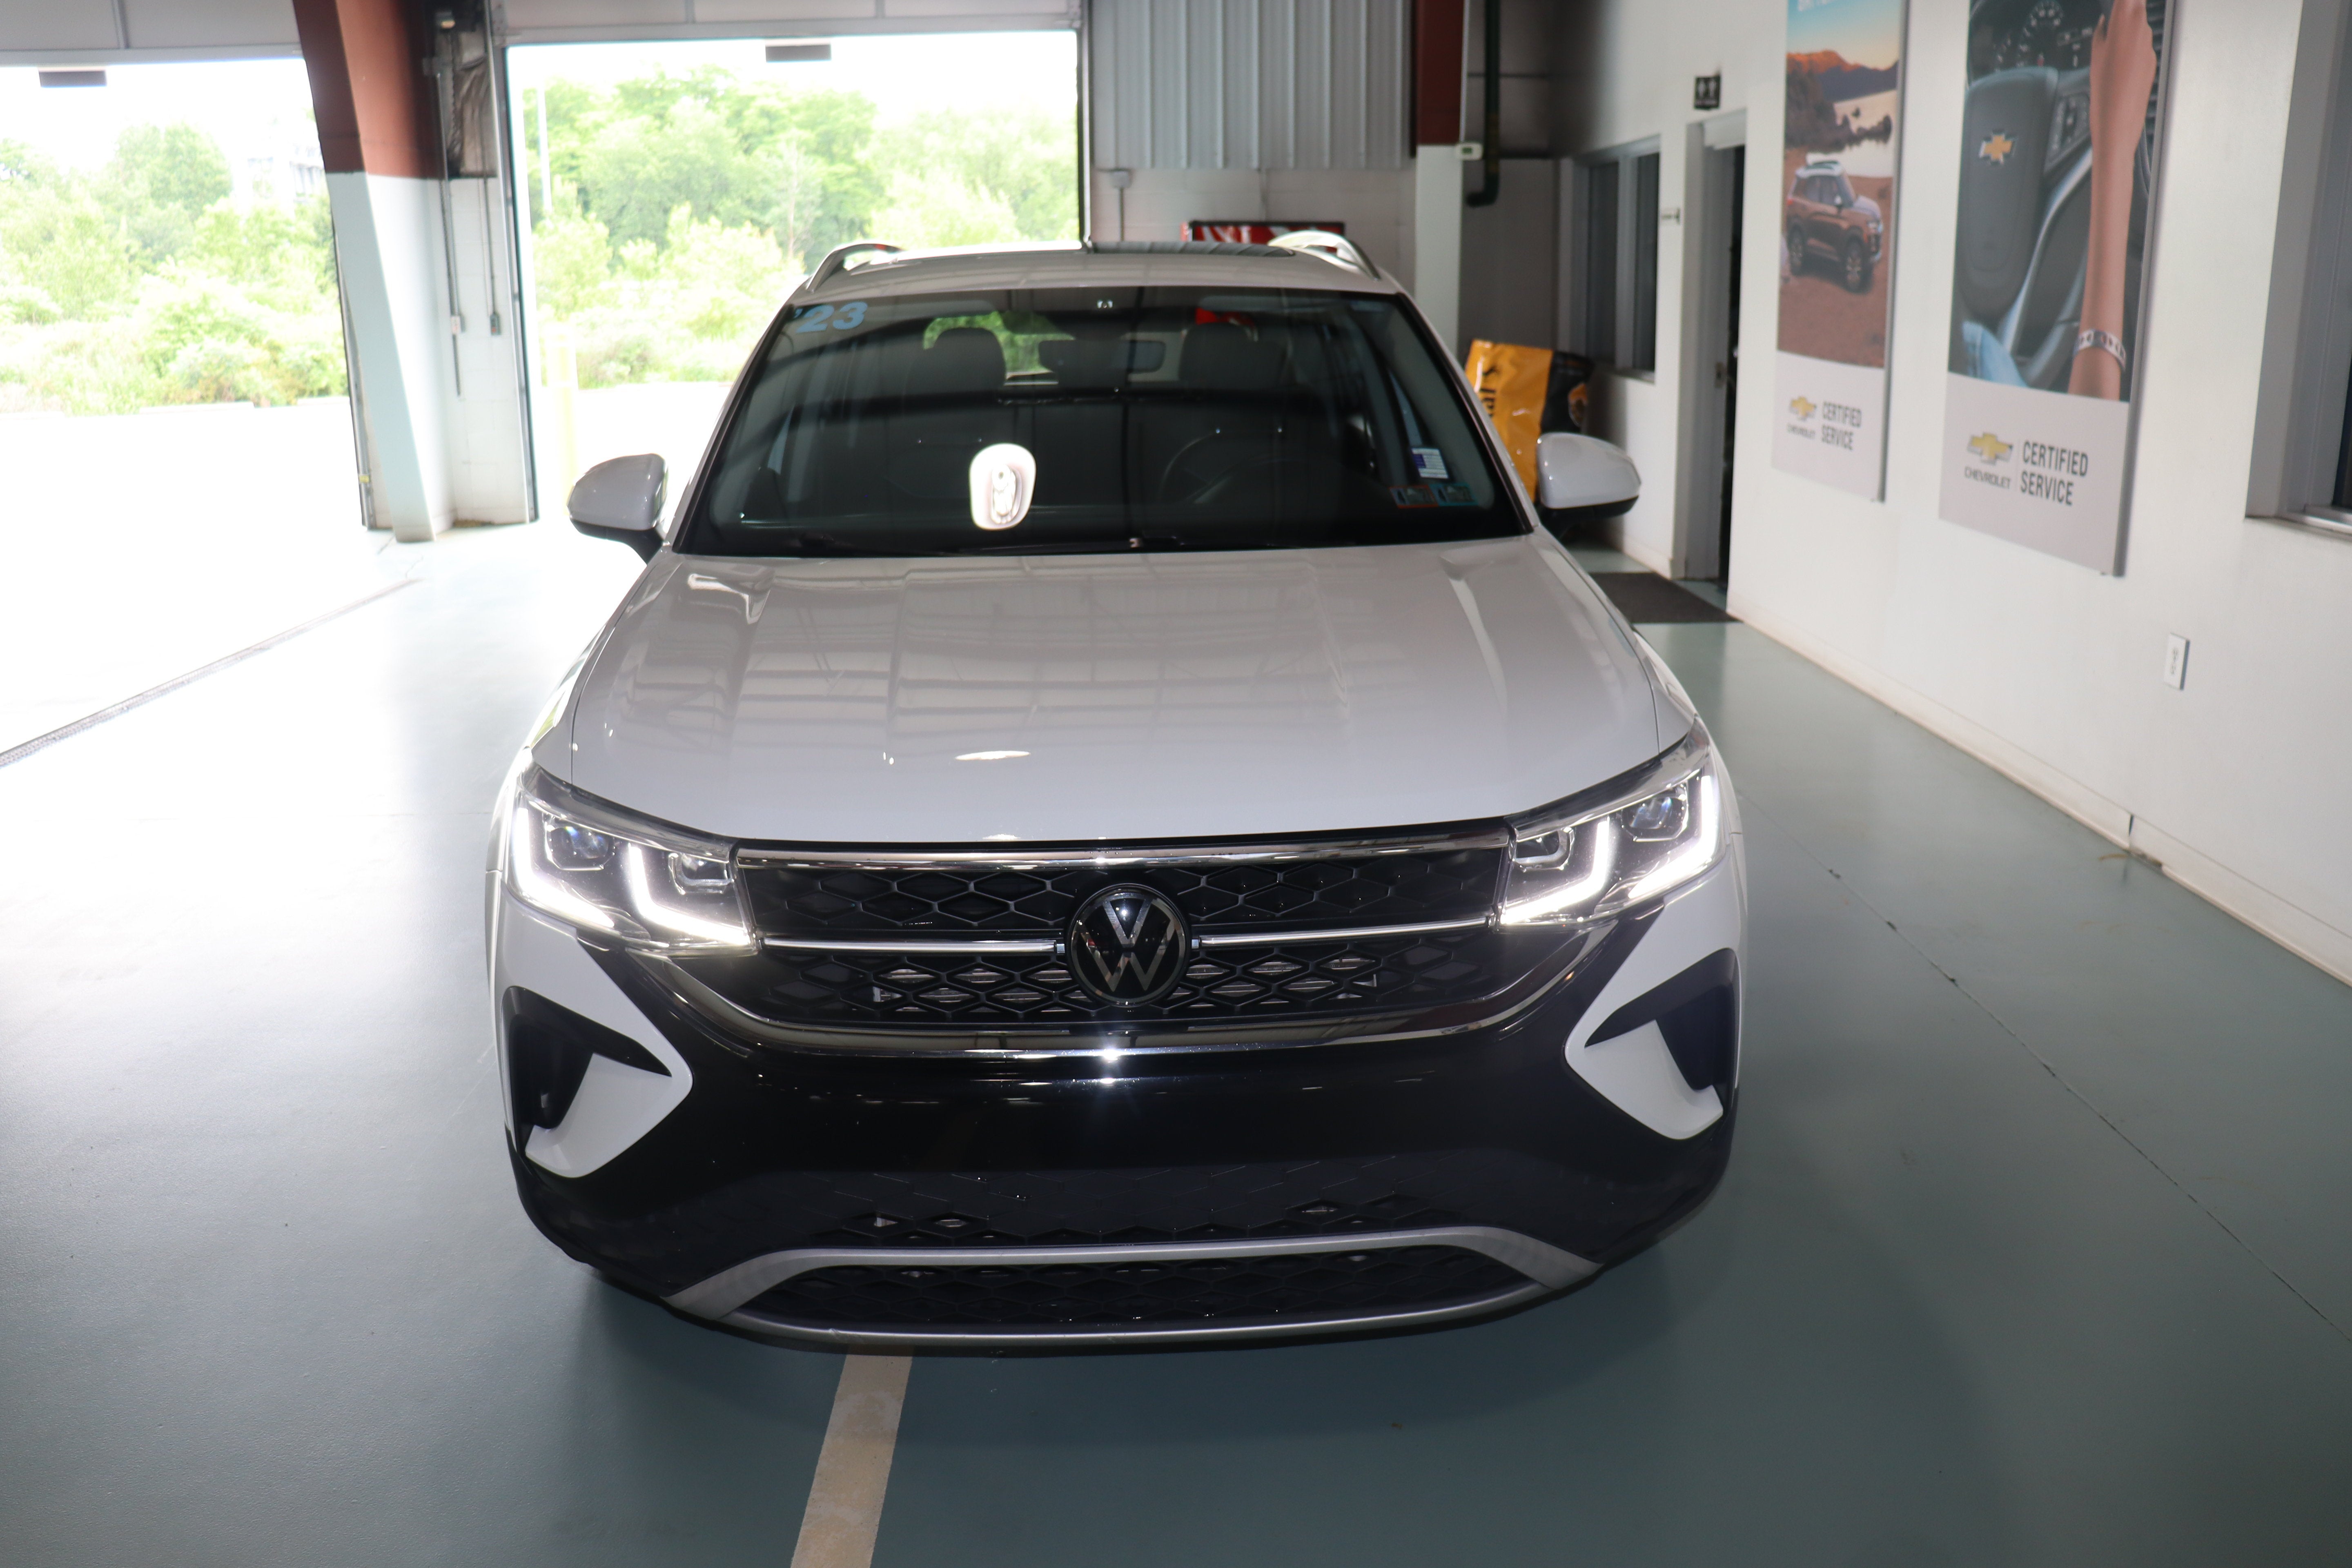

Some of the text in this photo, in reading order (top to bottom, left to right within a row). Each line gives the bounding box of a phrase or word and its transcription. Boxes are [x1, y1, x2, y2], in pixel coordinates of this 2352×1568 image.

[1822, 401, 1862, 428] CERTIFIED
[1821, 423, 1854, 450] SERVICE
[2023, 440, 2089, 477] CERTIFIED
[1964, 466, 2011, 489] CHEVROLET
[2021, 471, 2074, 506] SERVICE
